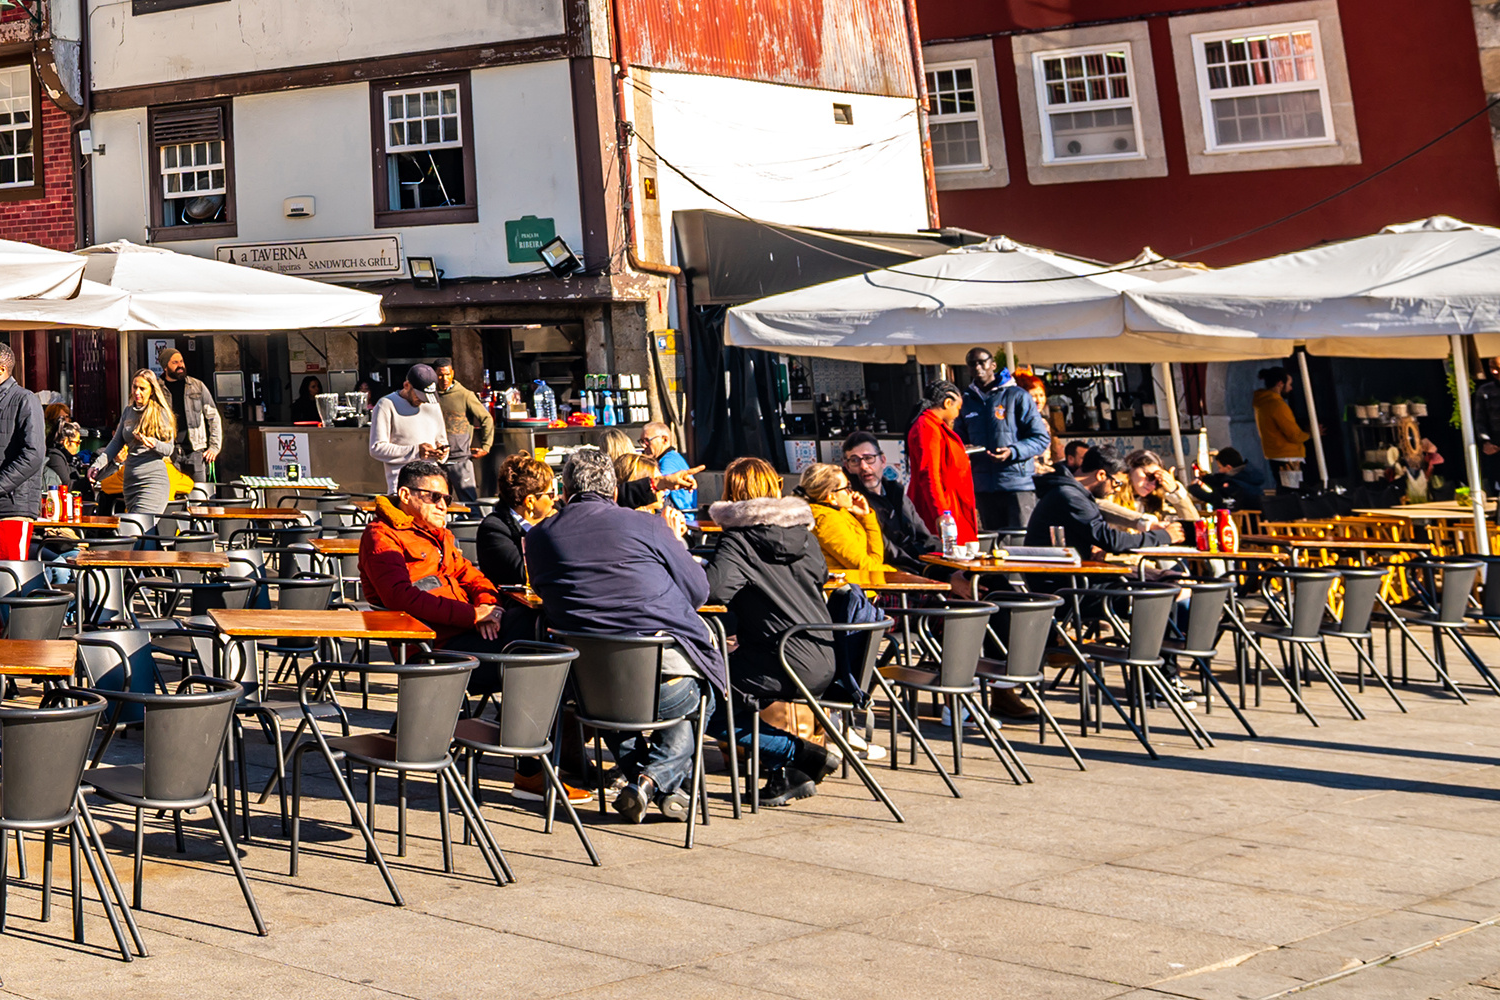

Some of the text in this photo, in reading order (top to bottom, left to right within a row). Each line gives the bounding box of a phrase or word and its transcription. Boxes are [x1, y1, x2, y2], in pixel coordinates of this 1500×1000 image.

[519, 240, 543, 248] RIBEIRA
[241, 246, 308, 262] a TAVERNA
[277, 262, 302, 273] ligeiras
[308, 256, 394, 270] SANDWICH & GRILL
